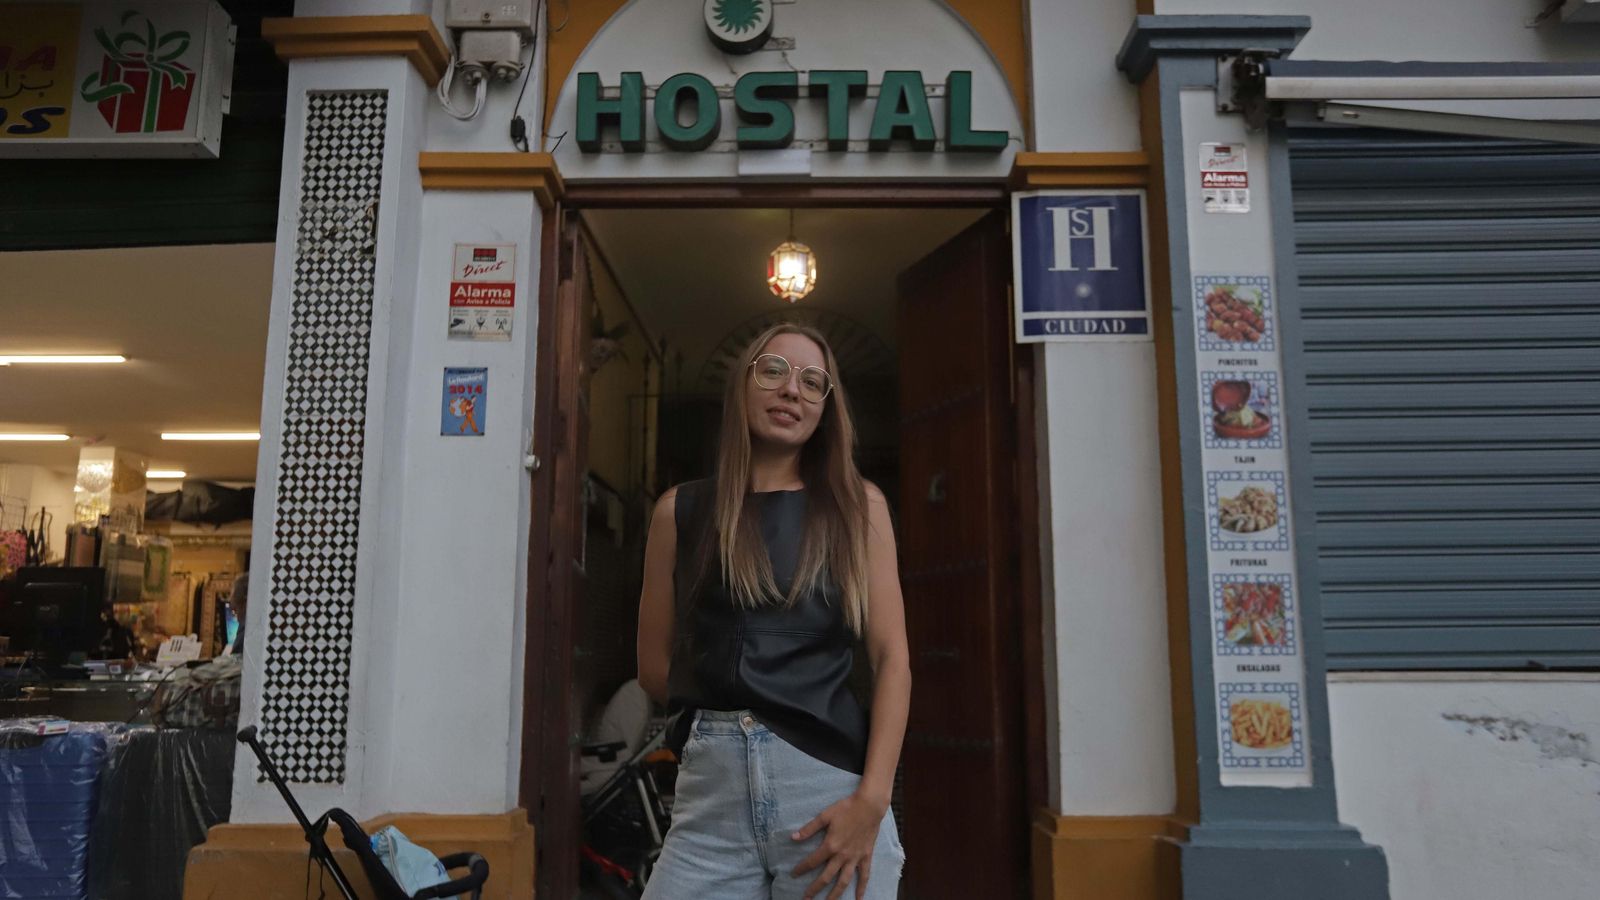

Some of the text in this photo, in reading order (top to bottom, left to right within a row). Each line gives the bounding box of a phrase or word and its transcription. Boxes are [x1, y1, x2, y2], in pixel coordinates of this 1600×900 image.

[0, 46, 57, 71] A
[575, 70, 1009, 153] HOSTAL
[0, 107, 66, 134] S
[1204, 172, 1246, 182] Alarma
[463, 260, 508, 278] Direct
[454, 284, 512, 298] Alarma
[1045, 319, 1126, 333] CIUDAD
[1218, 358, 1258, 366] PINCHITOS
[1234, 455, 1256, 464] TAJIN
[1230, 558, 1267, 566] FRITURAS
[1236, 663, 1281, 673] ENSALADAS
